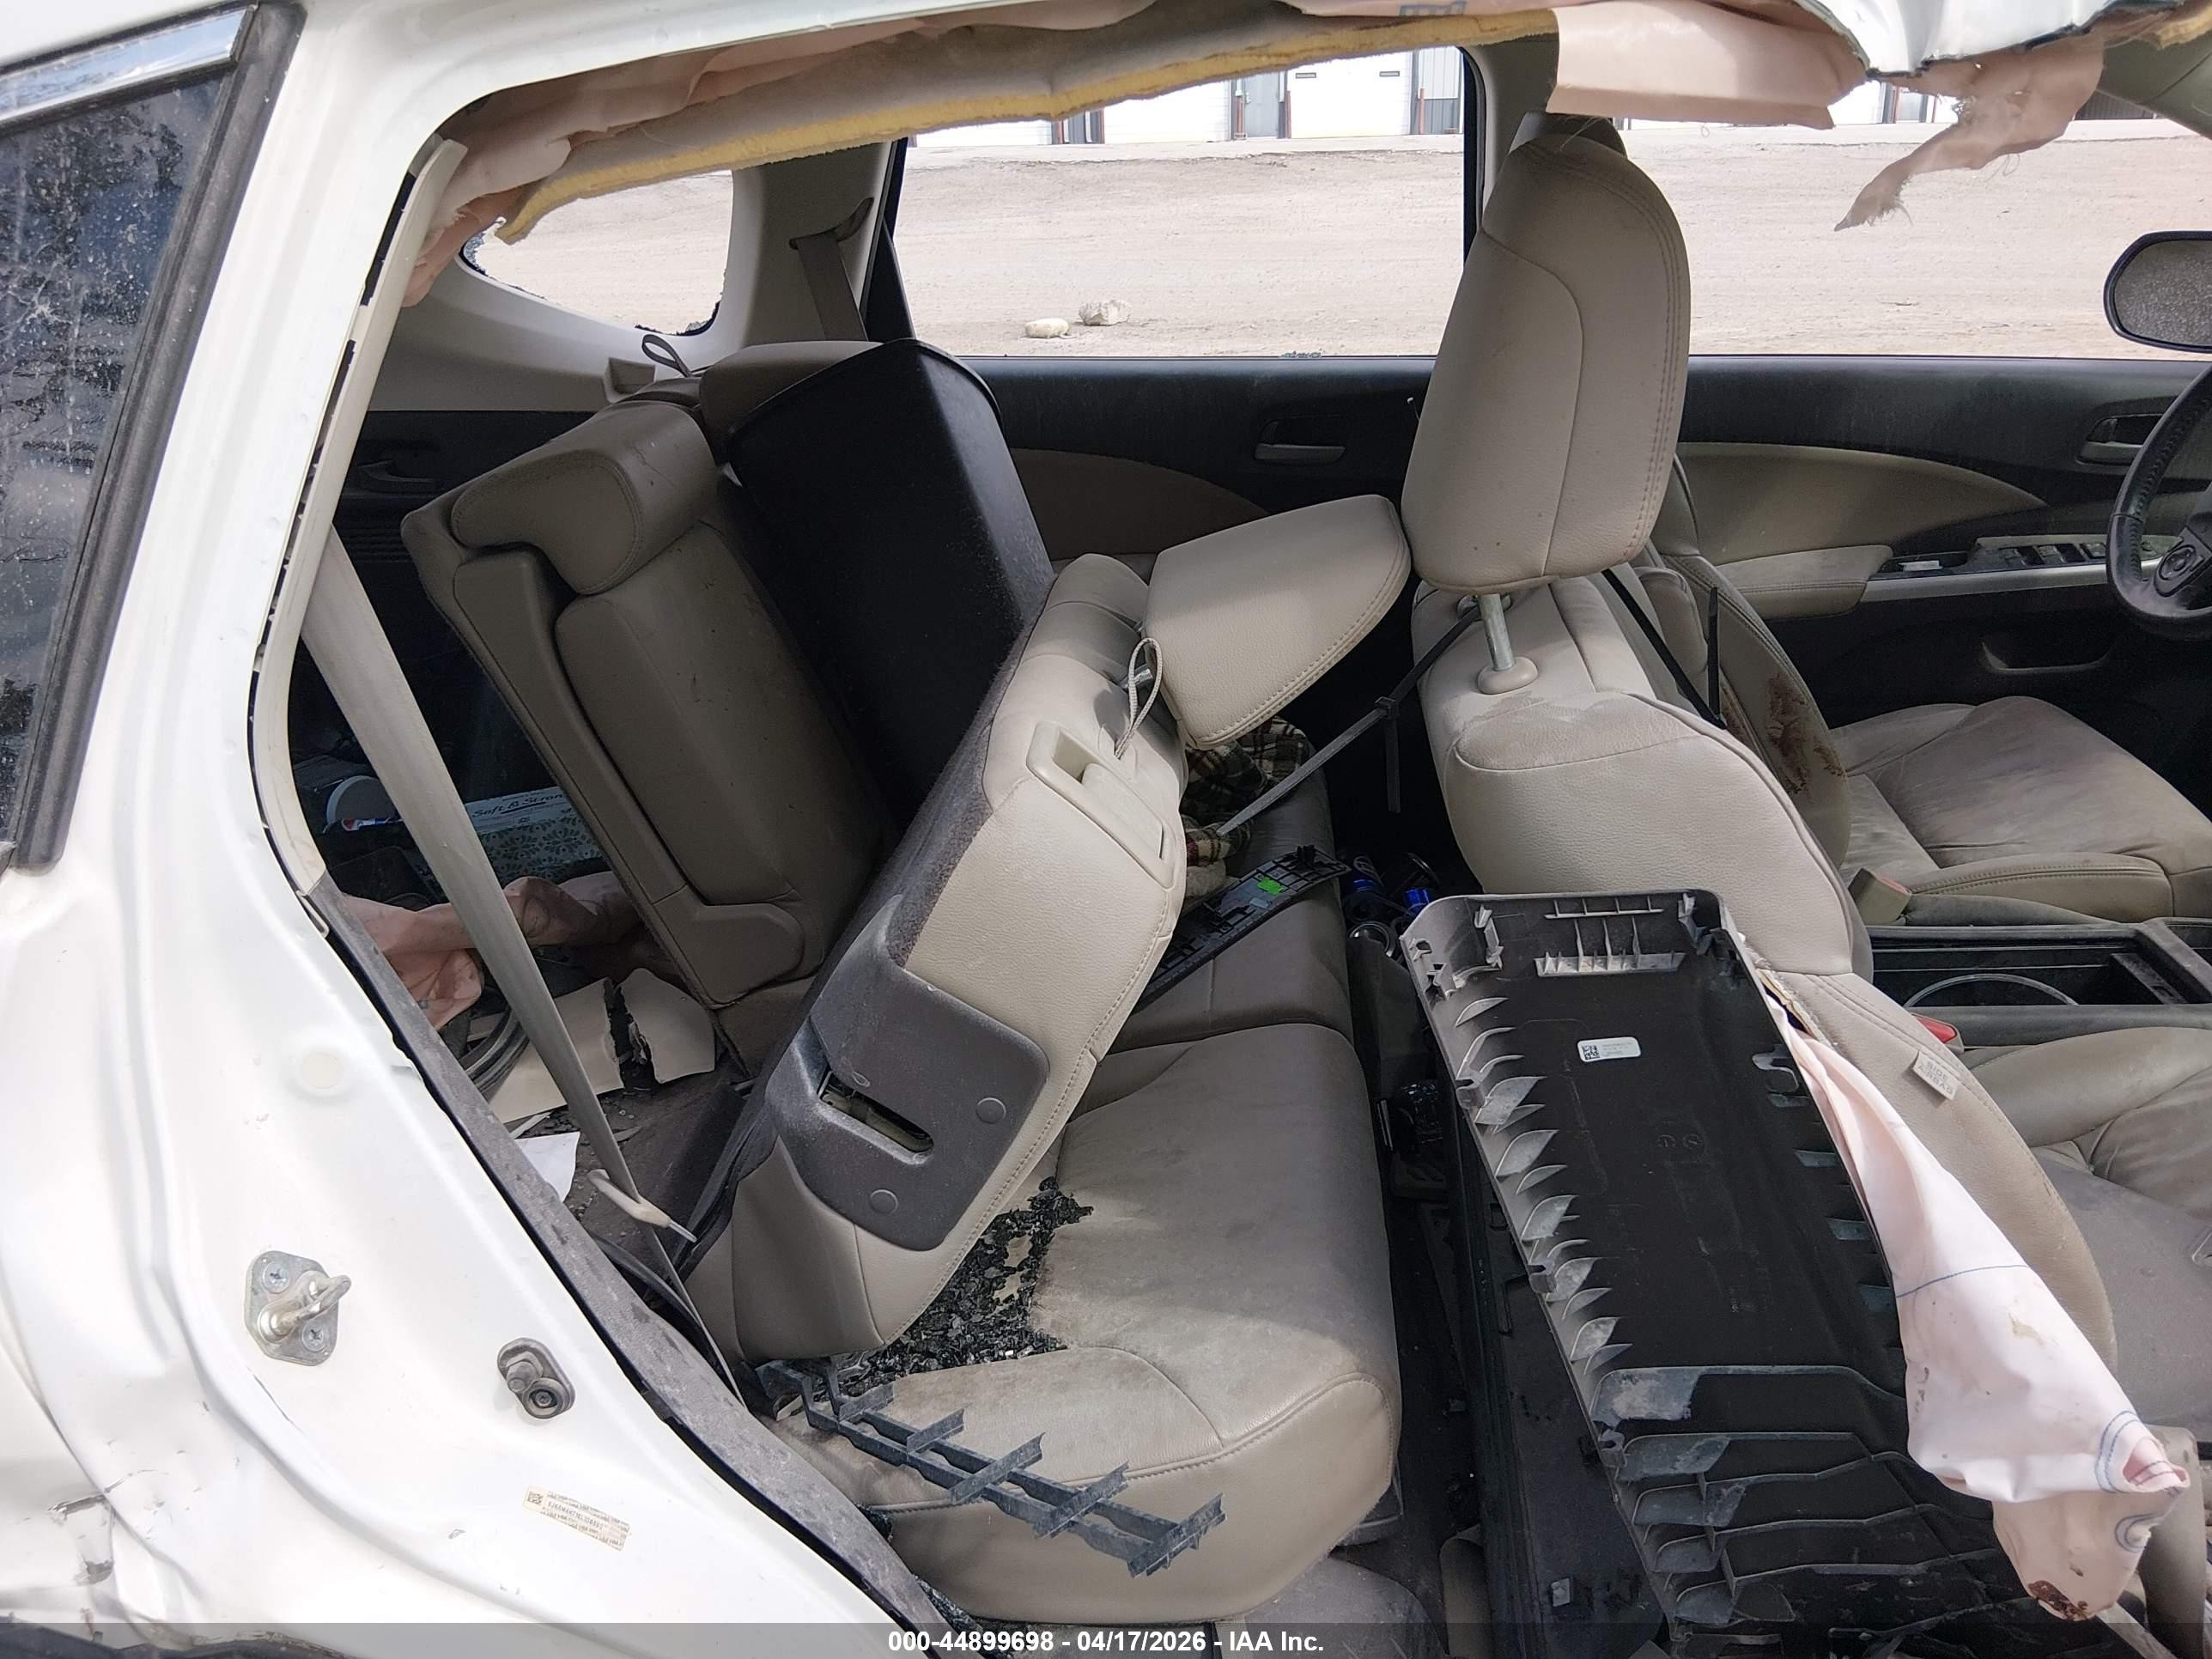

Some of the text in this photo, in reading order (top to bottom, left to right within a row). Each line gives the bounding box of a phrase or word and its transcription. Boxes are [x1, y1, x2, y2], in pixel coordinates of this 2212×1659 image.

[472, 805, 503, 817] Soft
[522, 794, 564, 805] Stron
[1917, 1065, 1953, 1095] AIRBAG
[1927, 1060, 1950, 1081] SIDE
